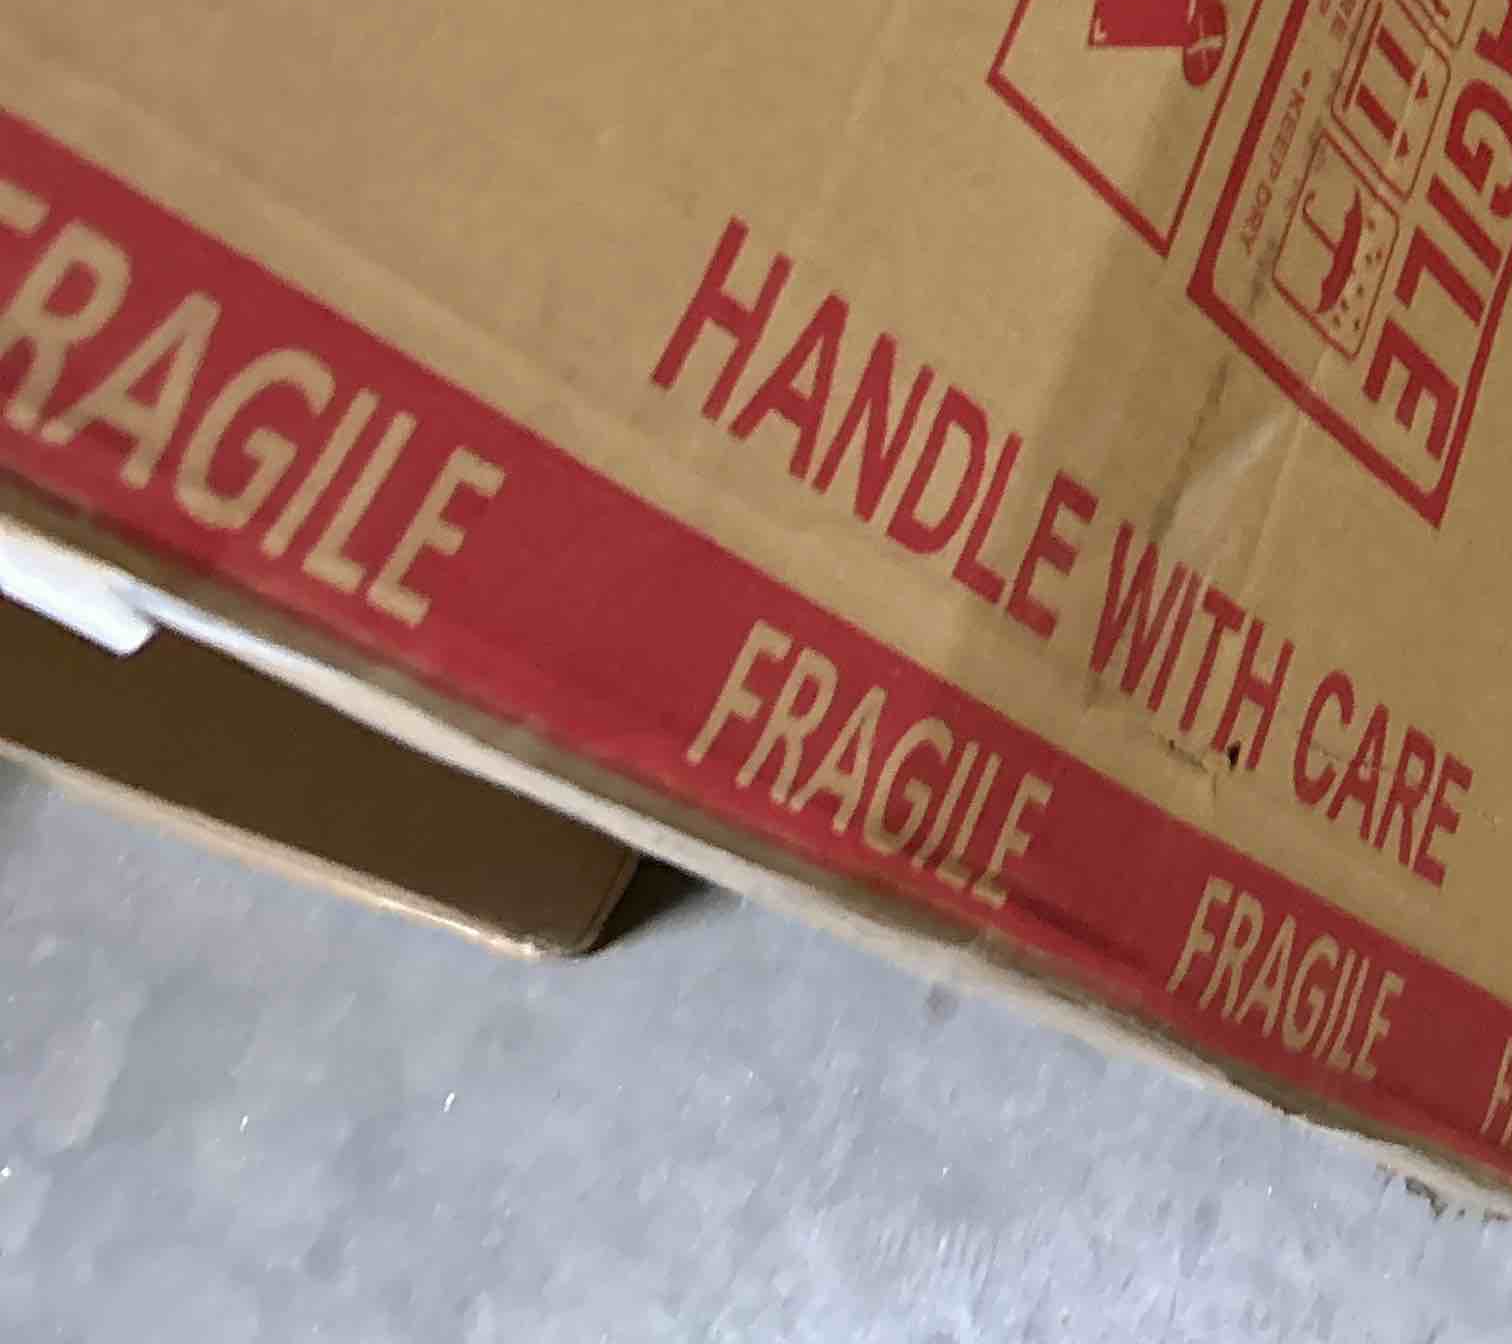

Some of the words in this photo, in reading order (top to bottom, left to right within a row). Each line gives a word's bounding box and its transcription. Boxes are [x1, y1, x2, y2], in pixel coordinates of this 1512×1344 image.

[0, 178, 506, 628] RAGILE
[650, 217, 1099, 640] HANDLE
[1087, 522, 1293, 771] WITH
[1291, 668, 1474, 887] CARE
[686, 618, 1052, 910] FRAGILE
[1166, 875, 1405, 1082] FRAGILE
